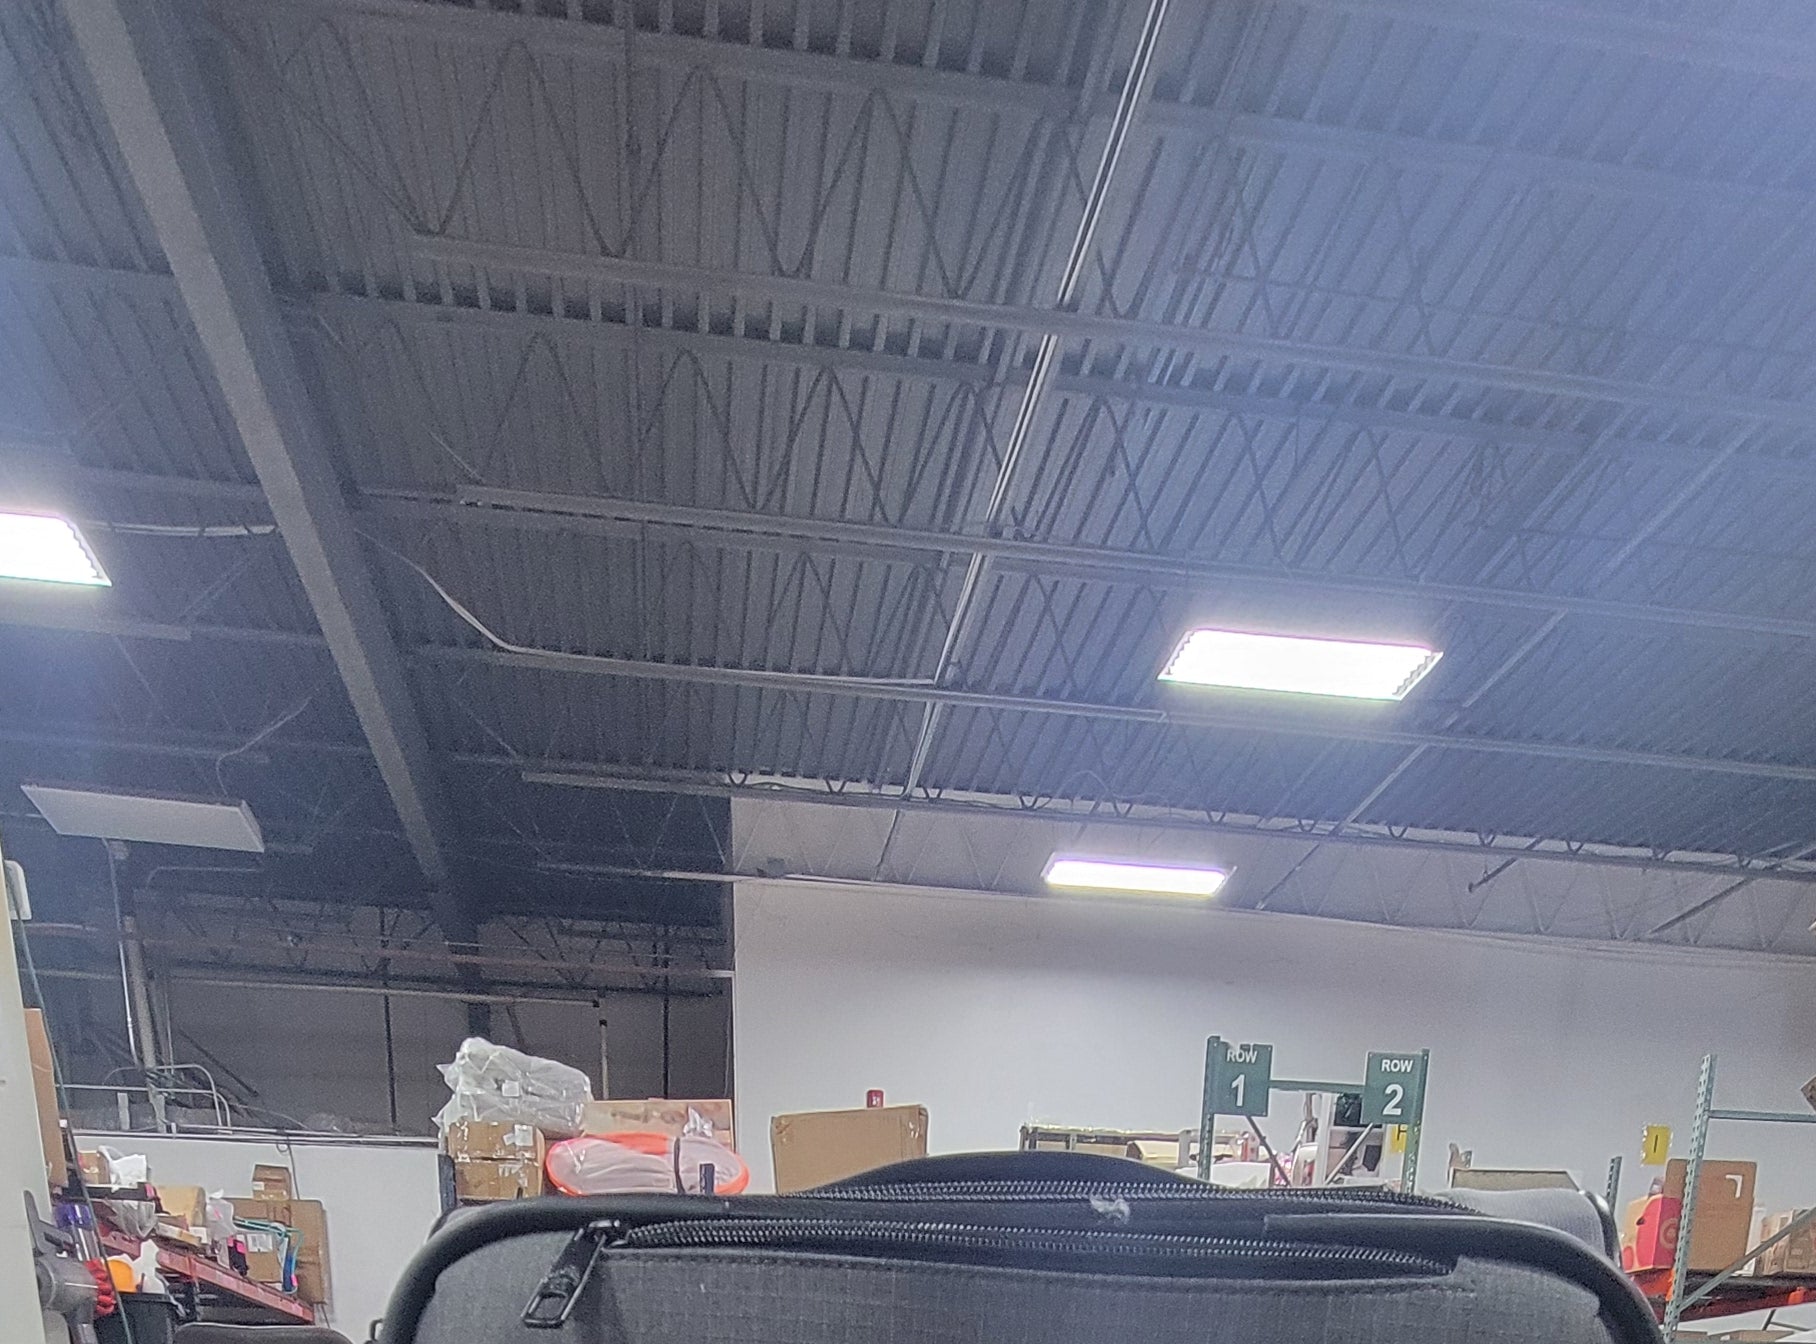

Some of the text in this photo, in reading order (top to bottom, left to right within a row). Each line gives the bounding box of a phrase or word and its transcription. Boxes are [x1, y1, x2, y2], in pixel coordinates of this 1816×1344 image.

[1226, 1048, 1258, 1064] ROW
[1381, 1059, 1413, 1073] ROW
[1231, 1074, 1245, 1107] 1
[1382, 1083, 1404, 1116] 2
